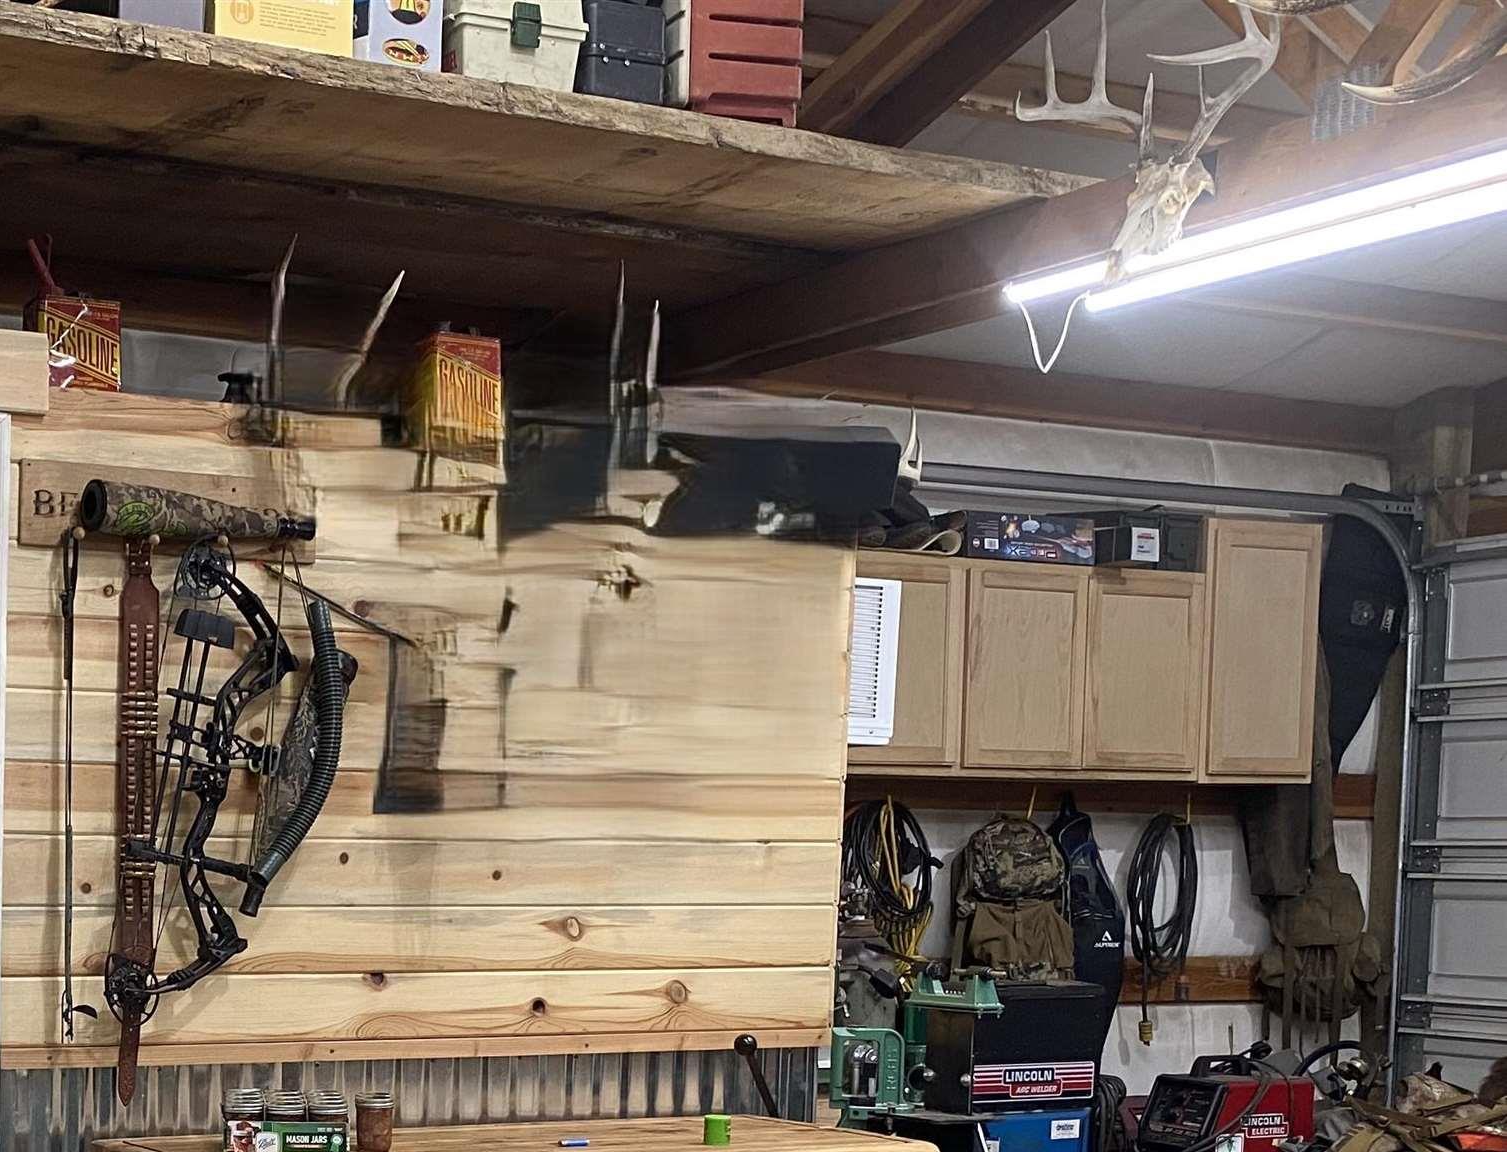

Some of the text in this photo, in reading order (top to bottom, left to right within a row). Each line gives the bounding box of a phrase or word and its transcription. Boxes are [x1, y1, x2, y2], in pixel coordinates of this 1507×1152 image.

[47, 316, 118, 377] GASOLINE
[438, 358, 499, 416] GASOLINE
[1005, 1070, 1053, 1083] LINCOLN
[1015, 1085, 1058, 1094] ARC WELDER
[1251, 1127, 1286, 1136] ELECTRIC
[285, 1135, 328, 1144] MASON JARS
